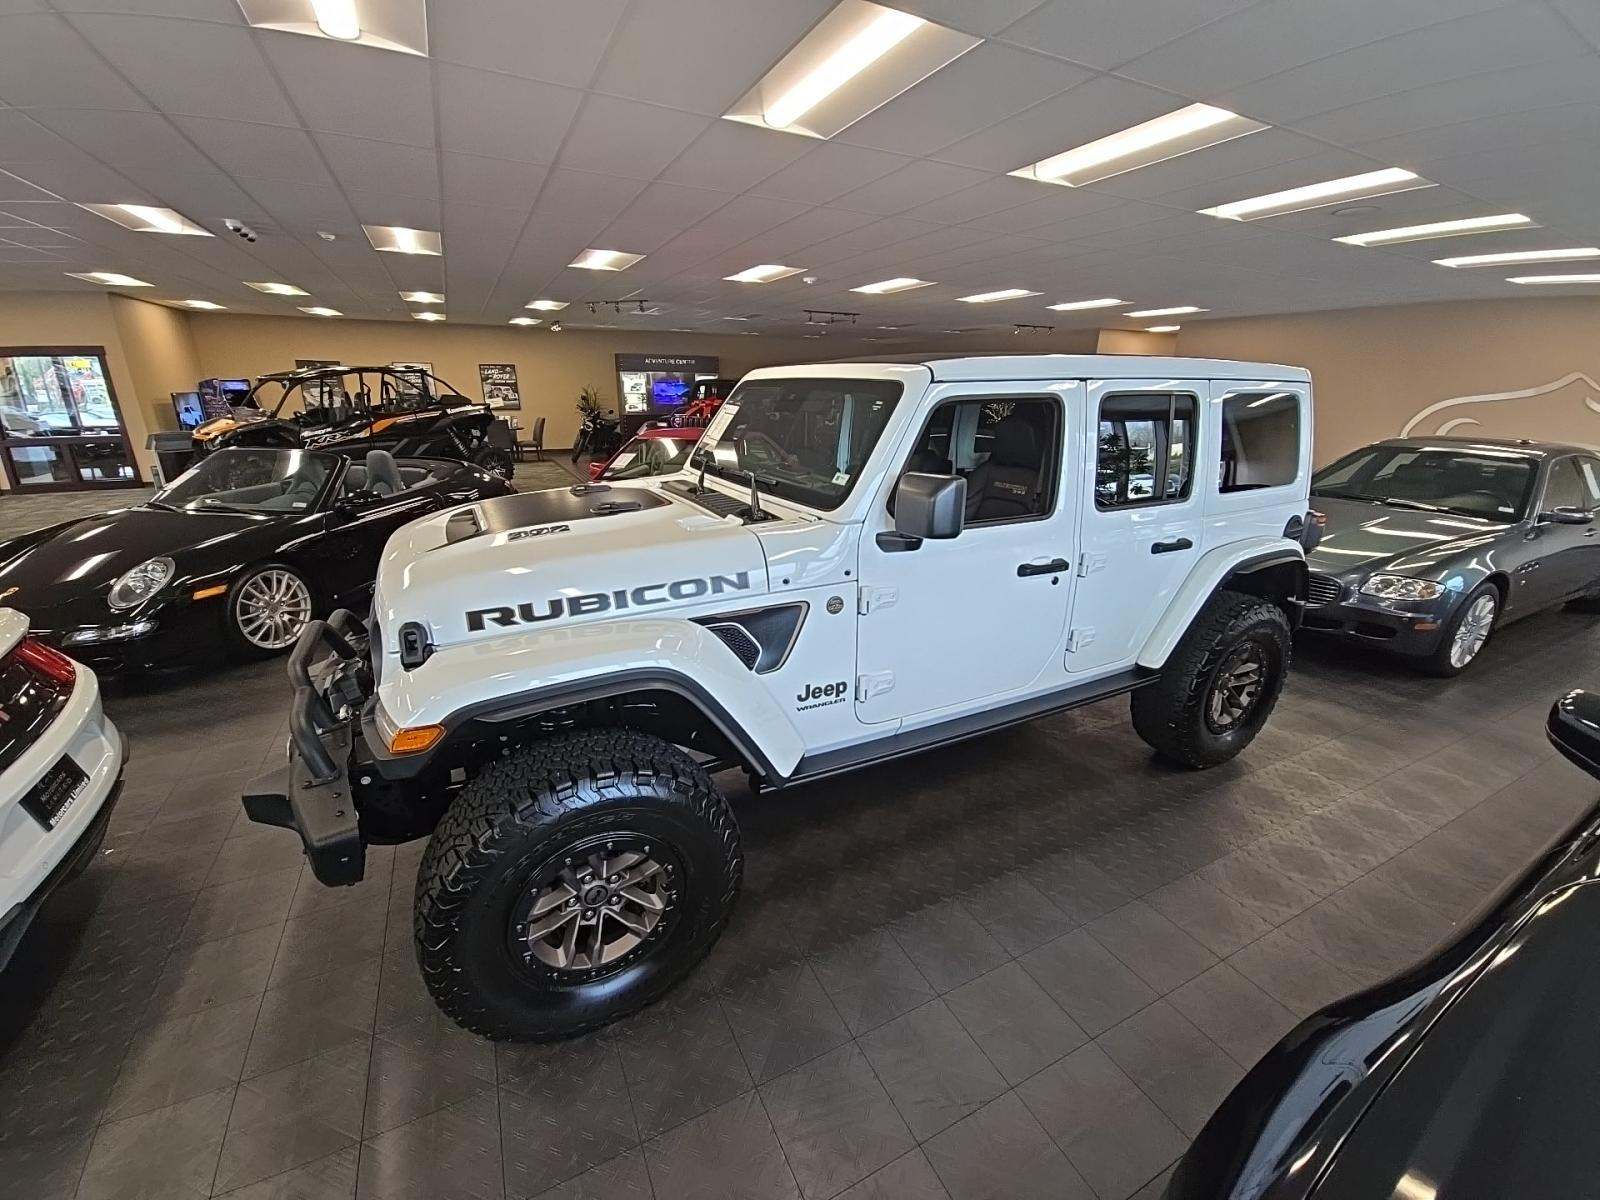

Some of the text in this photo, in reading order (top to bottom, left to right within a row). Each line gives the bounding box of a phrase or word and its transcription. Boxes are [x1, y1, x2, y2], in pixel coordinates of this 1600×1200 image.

[465, 571, 749, 632] RUBICON
[796, 681, 847, 702] Jeep
[796, 697, 846, 712] WRANGLER
